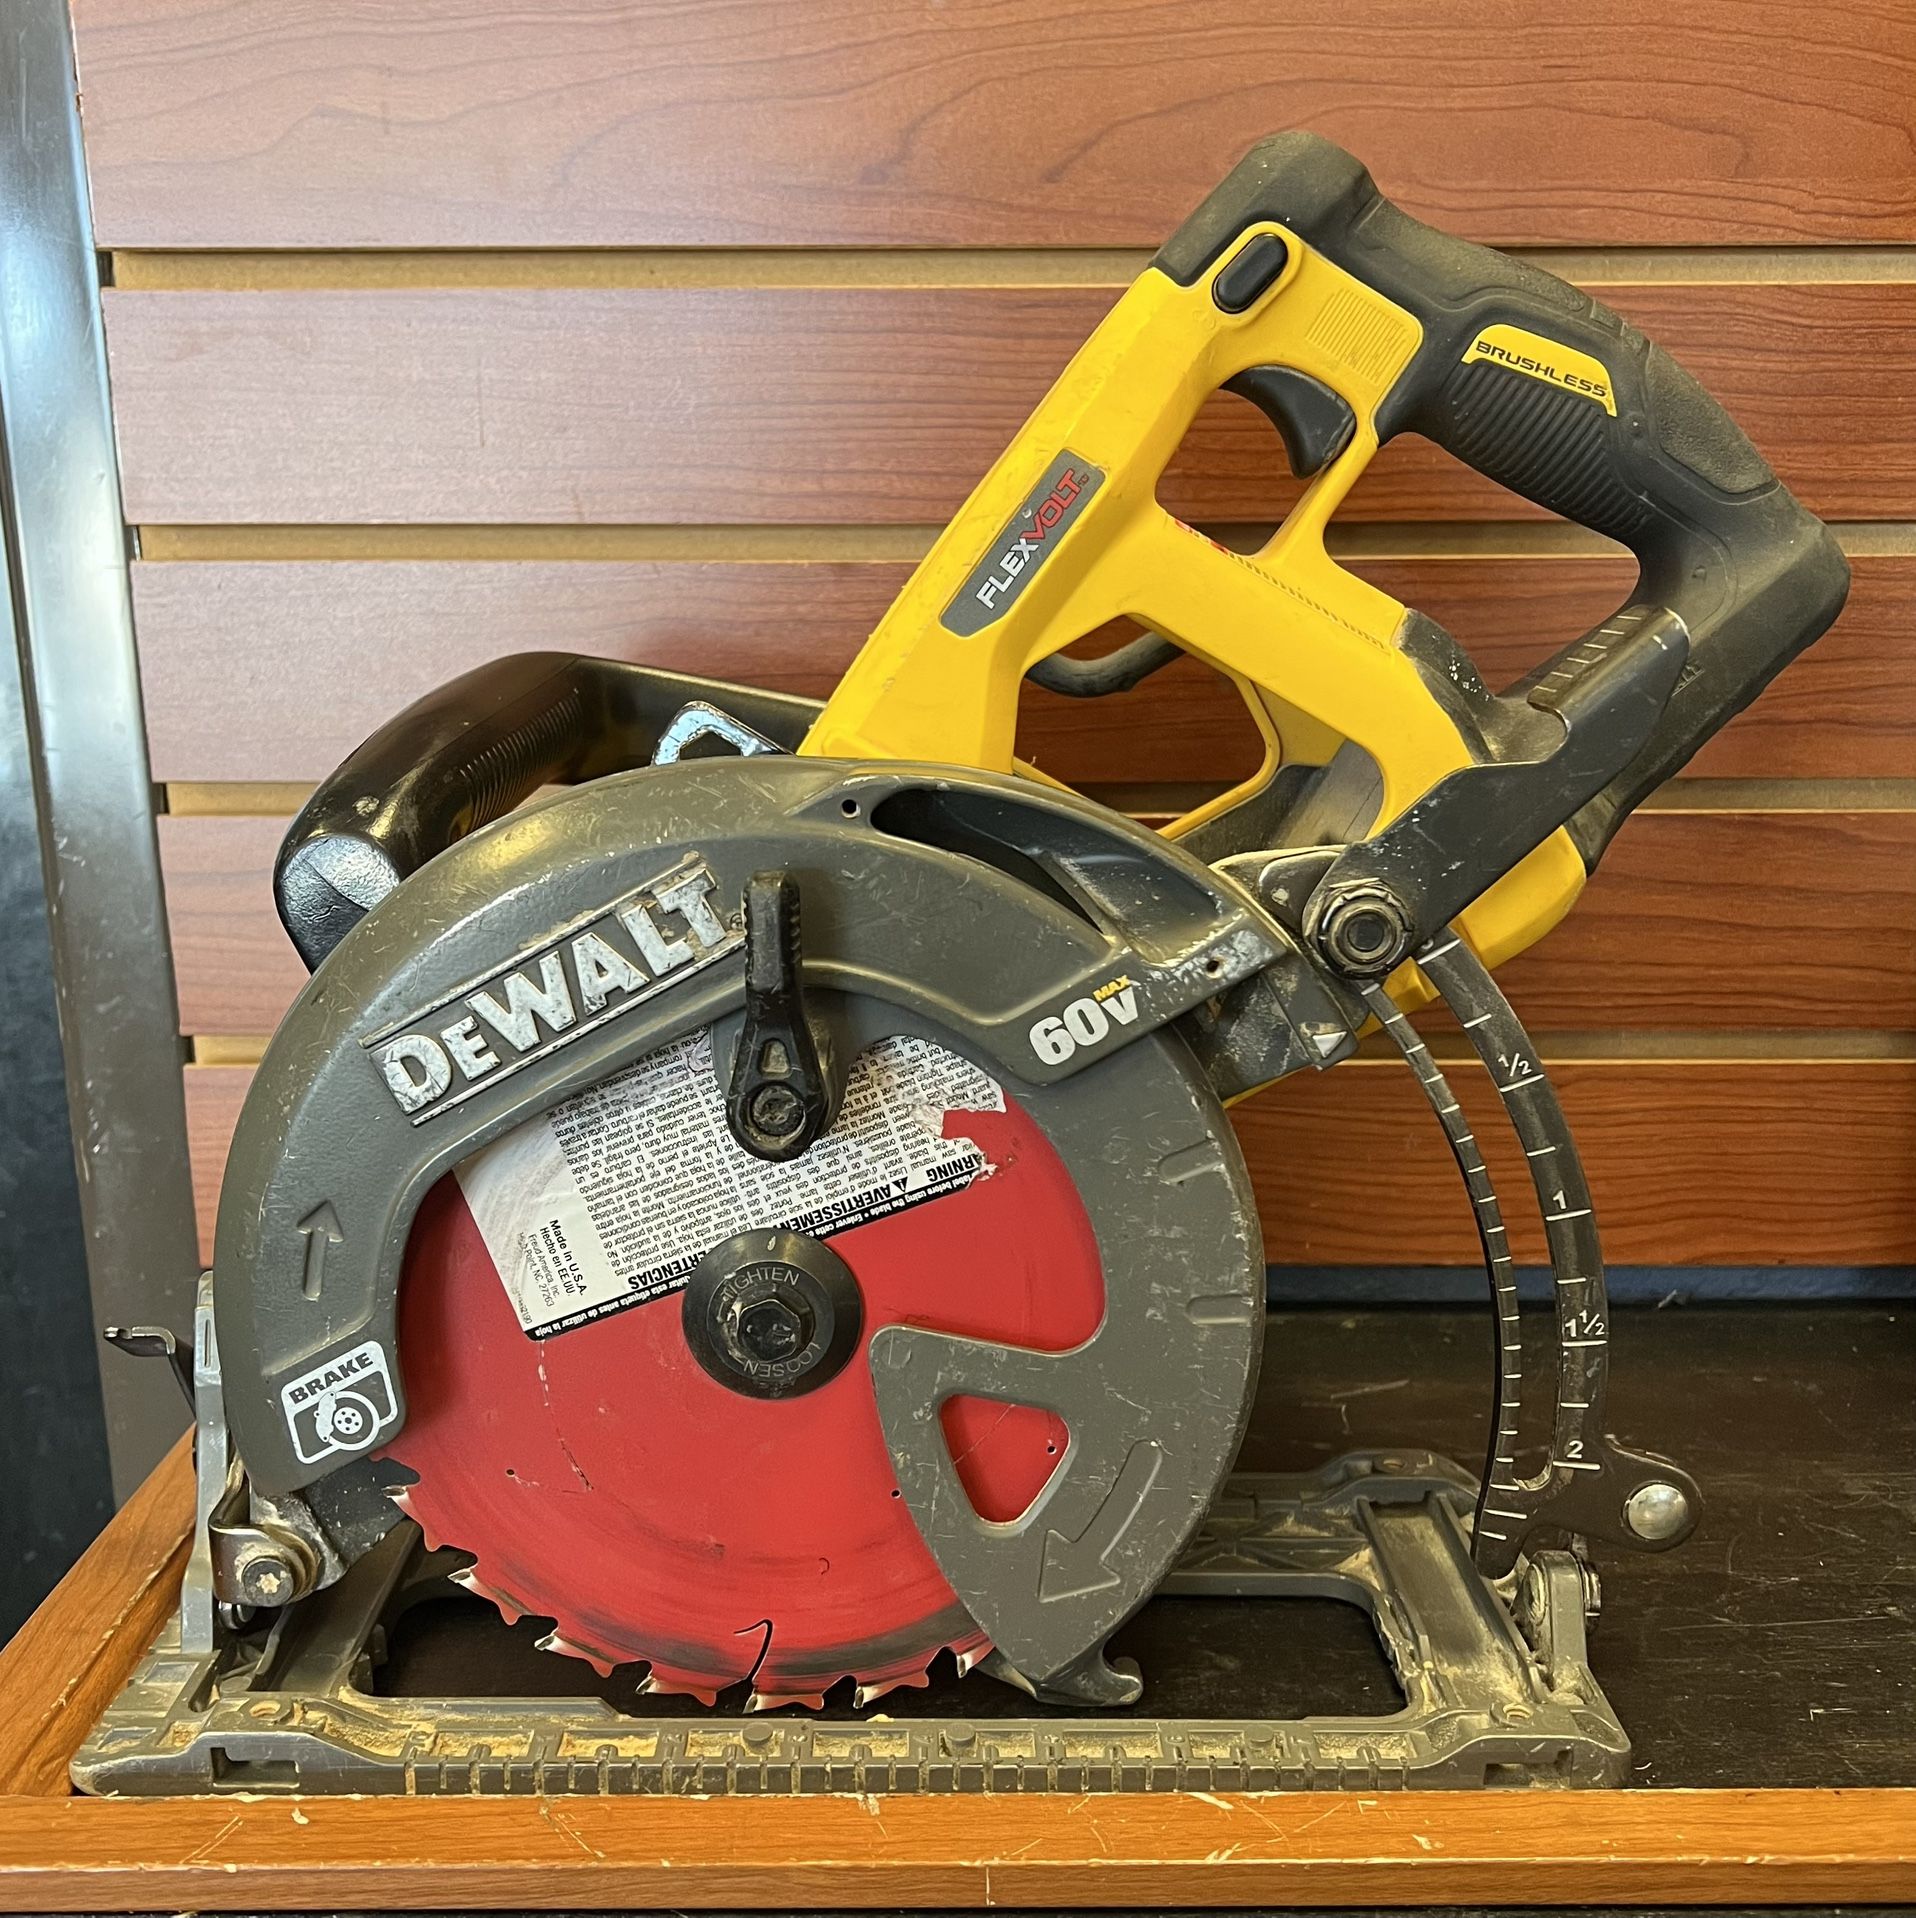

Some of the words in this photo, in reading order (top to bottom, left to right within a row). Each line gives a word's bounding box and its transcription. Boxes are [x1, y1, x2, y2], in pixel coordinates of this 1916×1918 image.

[1475, 340, 1608, 397] BRUSHLESS
[975, 468, 1082, 610] FLEXVOLT
[368, 868, 726, 1115] DEWALT
[1093, 974, 1131, 1002] MAX
[925, 1151, 983, 1183] ARNING
[772, 1183, 893, 1238] AVERTISSEMEN
[1552, 1190, 1568, 1210] 1
[528, 1233, 542, 1254] Freud
[539, 1226, 557, 1255] Hecho
[551, 1255, 562, 1267] en
[549, 1218, 569, 1250] Made
[563, 1250, 574, 1261] in
[626, 1250, 709, 1290] ERTENCIAS
[538, 1282, 554, 1307] 27263
[568, 1262, 588, 1296] U.S.A.
[721, 1266, 800, 1301] TIGHTEN
[744, 1342, 821, 1378] LOOSEN
[288, 1352, 374, 1405] BRAKE
[1566, 1440, 1584, 1459] 2
